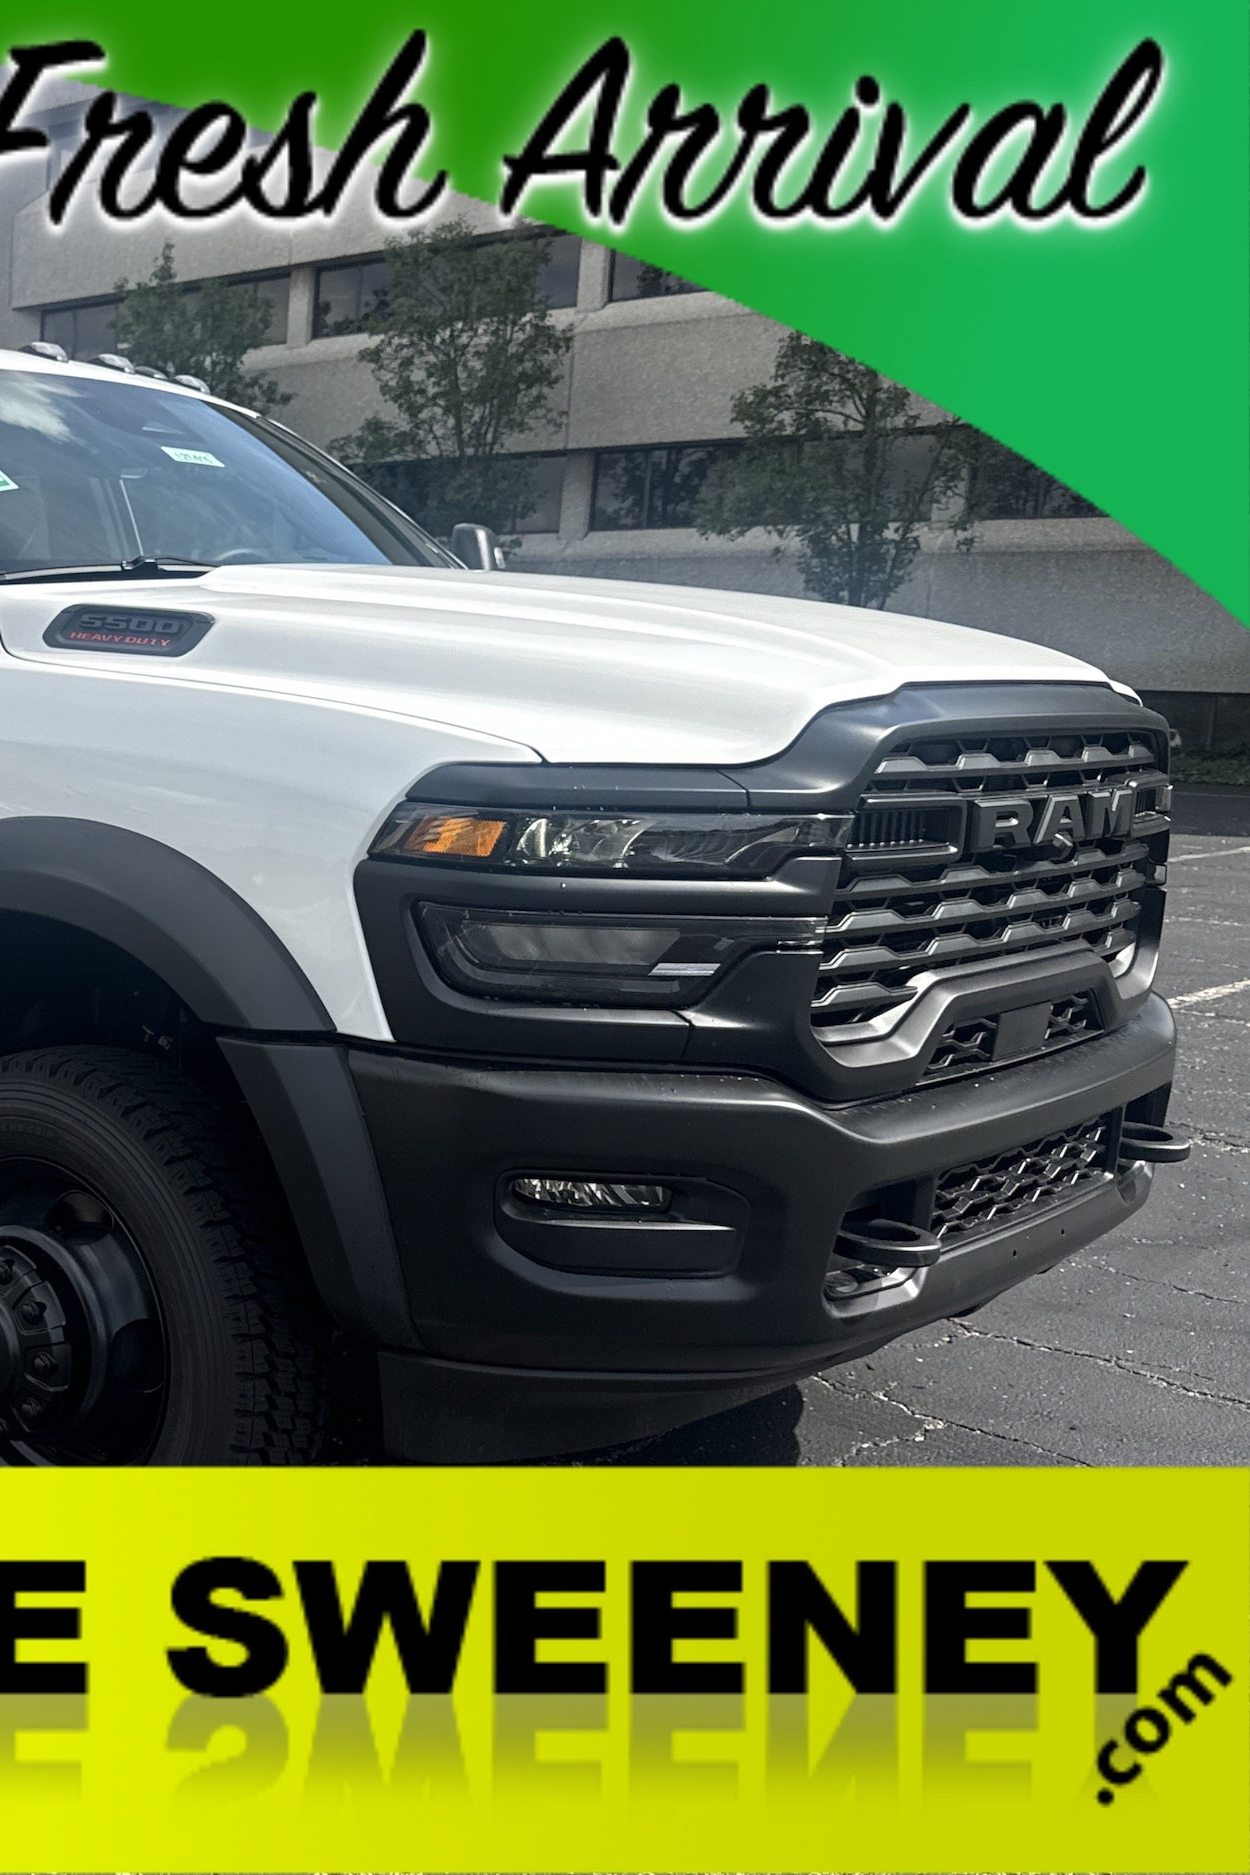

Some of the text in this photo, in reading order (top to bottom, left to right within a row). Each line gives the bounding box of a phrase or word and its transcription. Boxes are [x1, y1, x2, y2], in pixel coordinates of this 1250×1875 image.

[79, 613, 182, 635] 5500
[69, 631, 172, 648] HEAVY DUTY
[973, 788, 1134, 852] RAM
